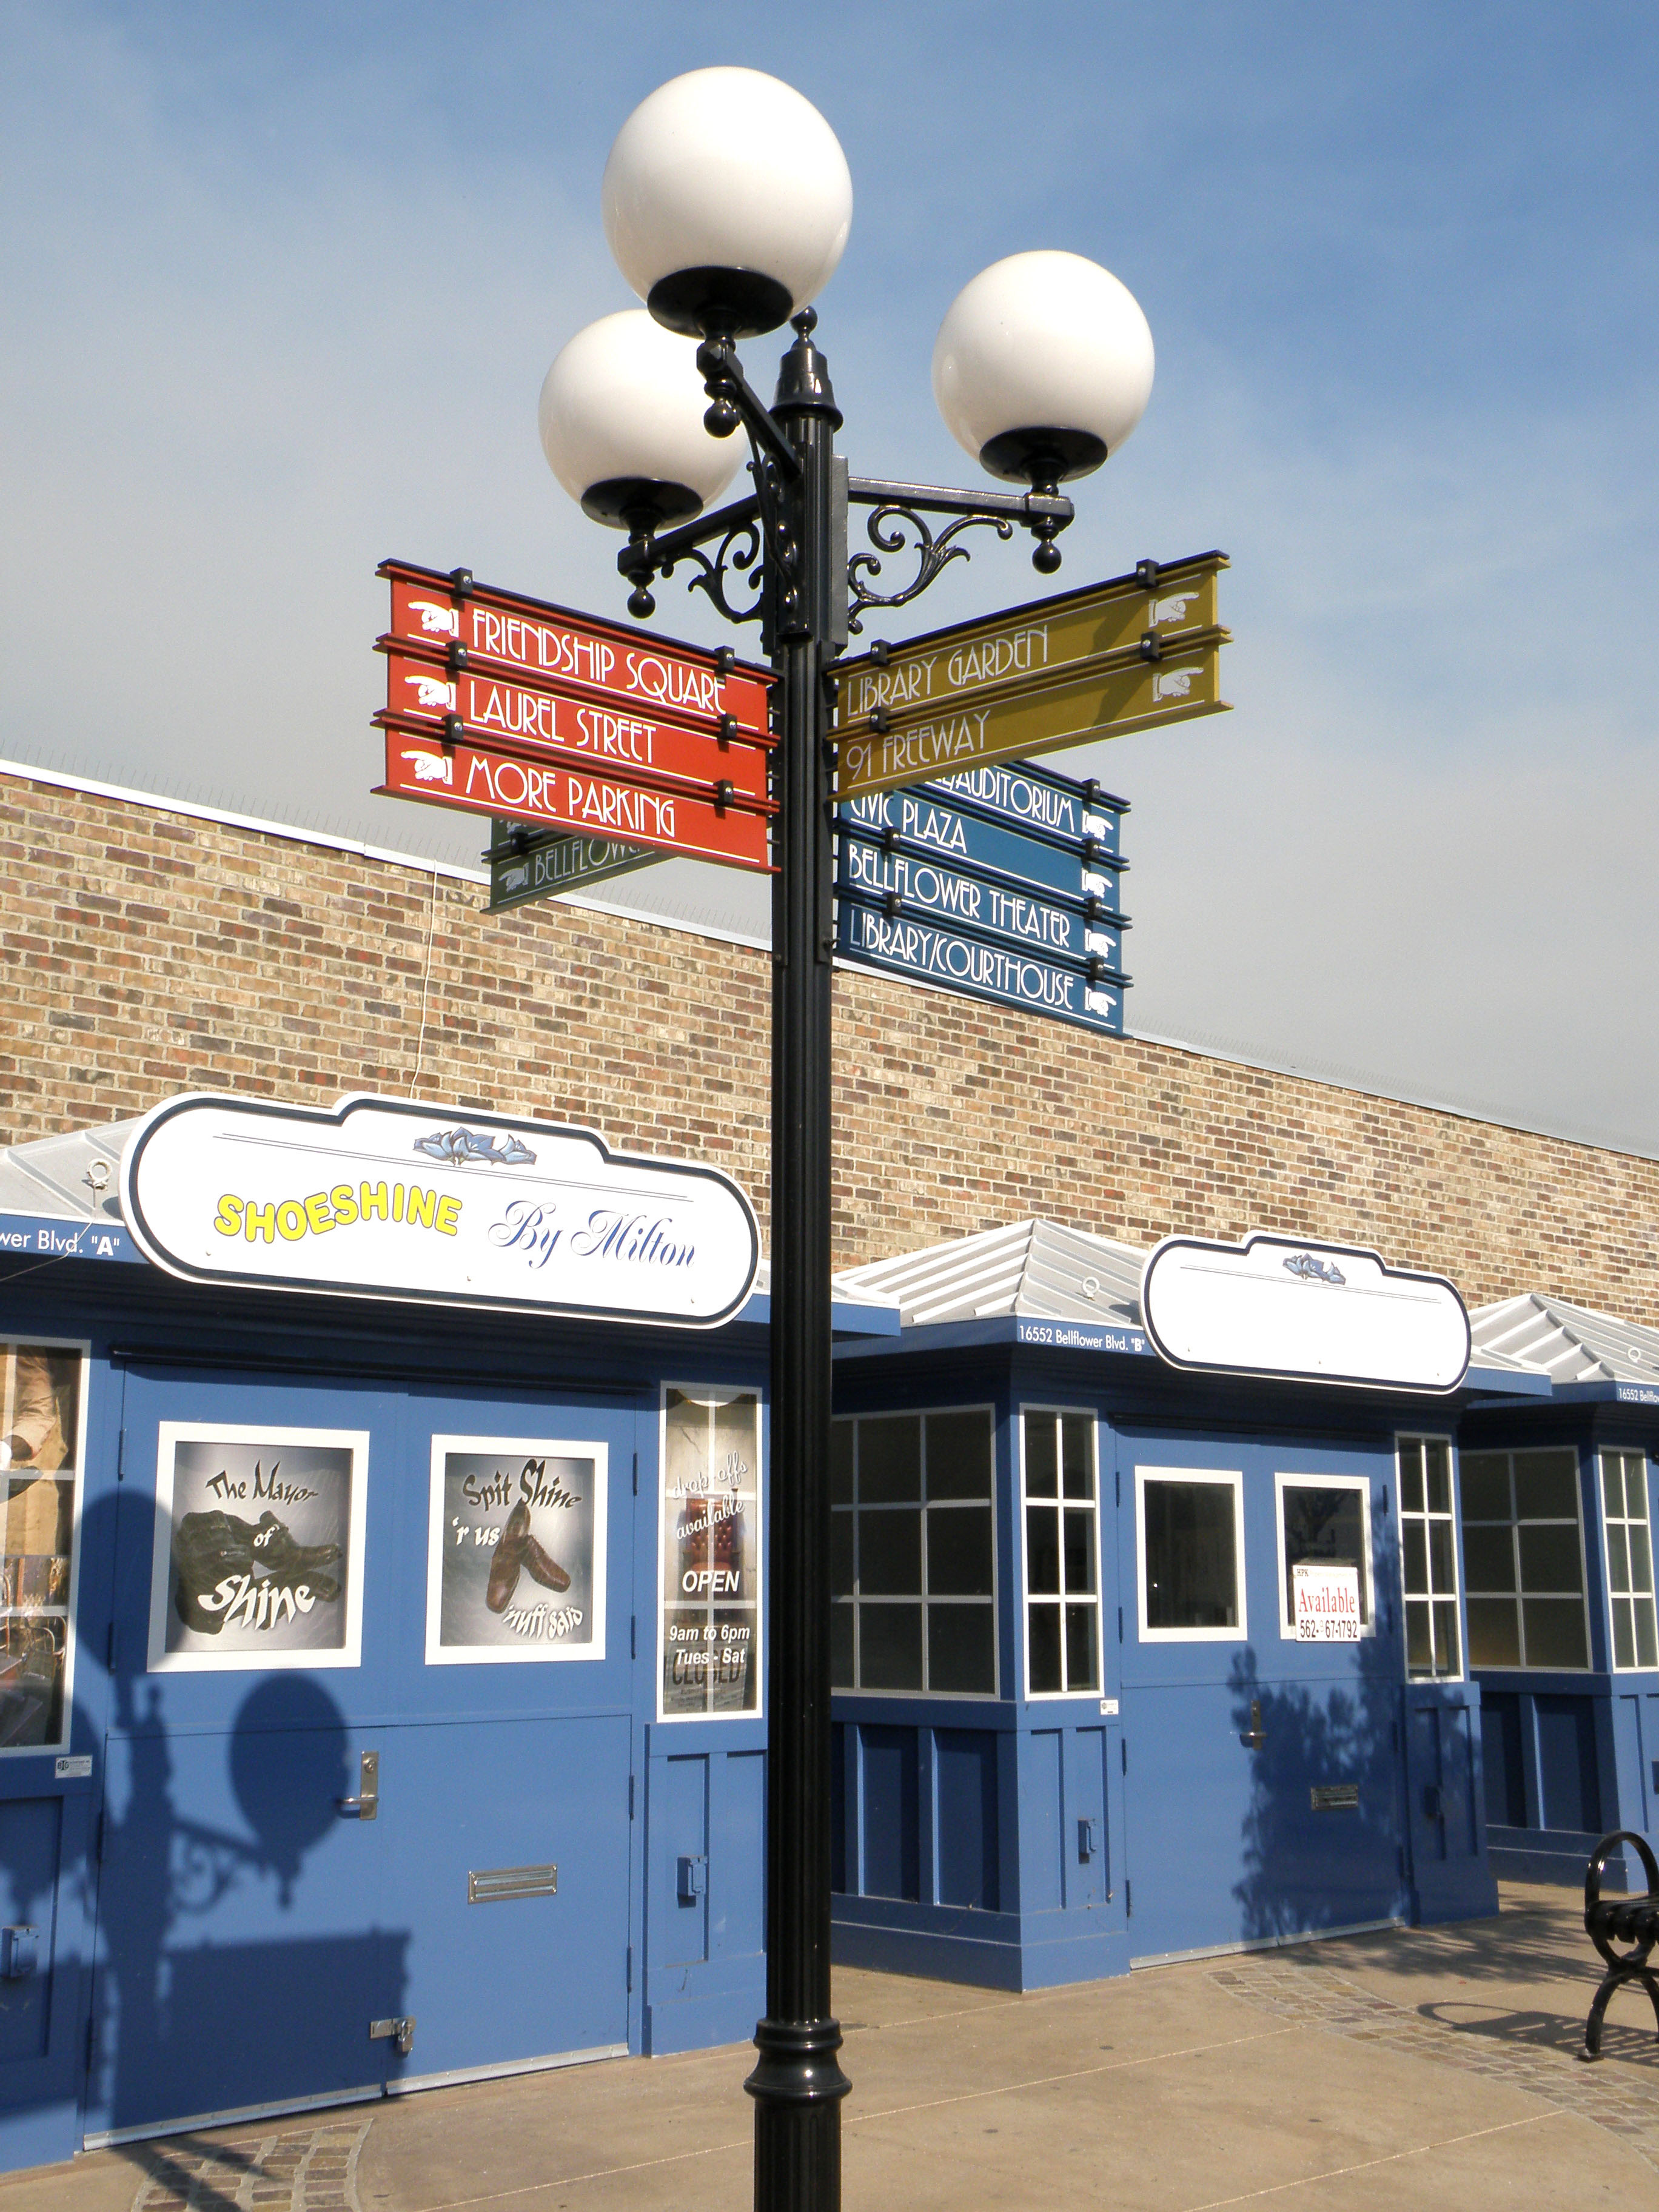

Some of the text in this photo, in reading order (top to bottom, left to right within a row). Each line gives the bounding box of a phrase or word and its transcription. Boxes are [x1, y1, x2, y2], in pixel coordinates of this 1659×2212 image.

[472, 608, 726, 715] FRIENDSHIP SQUARE
[847, 625, 1048, 716] LIBRARY GARDEN
[469, 680, 657, 763] LAUREL STREET
[846, 710, 992, 781] 91 FREEWAY
[466, 755, 676, 839] MORE PARKING
[902, 798, 967, 854] PLAZA
[848, 843, 1071, 948] BELLFLOWER THEATER
[850, 909, 1074, 1010] LIBRARY/COURTHOUSE
[213, 1181, 463, 1244] SHOESHINE
[488, 1199, 695, 1269] By Milton
[38, 1229, 84, 1254] Blvd.
[92, 1235, 120, 1257] "A"
[1019, 1325, 1145, 1352] 16552 Bellflower Blvd. "B"
[1618, 1387, 1659, 1403] 16552 Bellflo
[205, 1459, 319, 1506] The Mayor
[462, 1458, 582, 1512] Spit Shine
[717, 1450, 748, 1486] offs
[253, 1524, 280, 1547] of
[474, 1526, 501, 1546] us
[677, 1491, 745, 1540] available
[197, 1574, 317, 1631] Shine
[682, 1570, 740, 1593] OPEN
[1298, 1586, 1356, 1614] Available
[548, 1606, 583, 1640] said
[669, 1624, 750, 1644] 9am to 6pm
[676, 1649, 709, 1664] Tues
[722, 1647, 746, 1664] Sat
